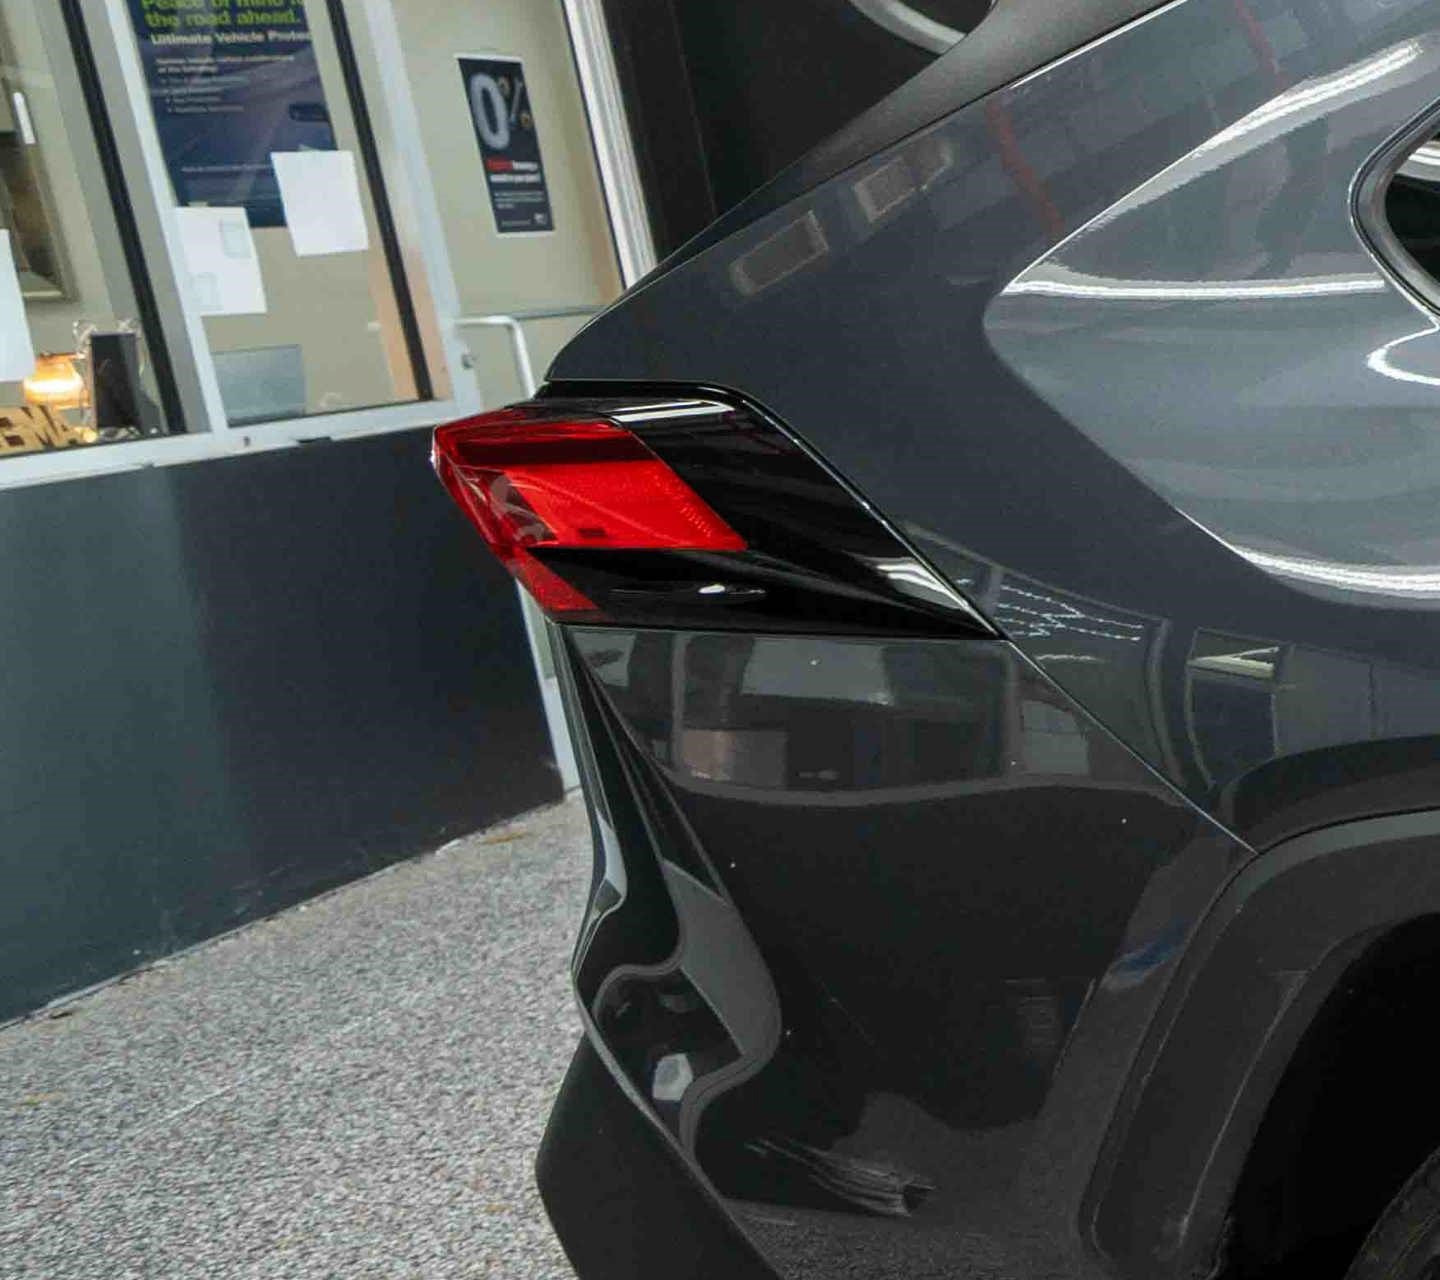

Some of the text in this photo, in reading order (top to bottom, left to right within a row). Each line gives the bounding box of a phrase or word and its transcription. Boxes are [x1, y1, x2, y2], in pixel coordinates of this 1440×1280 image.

[145, 9, 300, 28] the road ahead.
[150, 33, 212, 45] Ultimate
[215, 31, 265, 44] Vehicle
